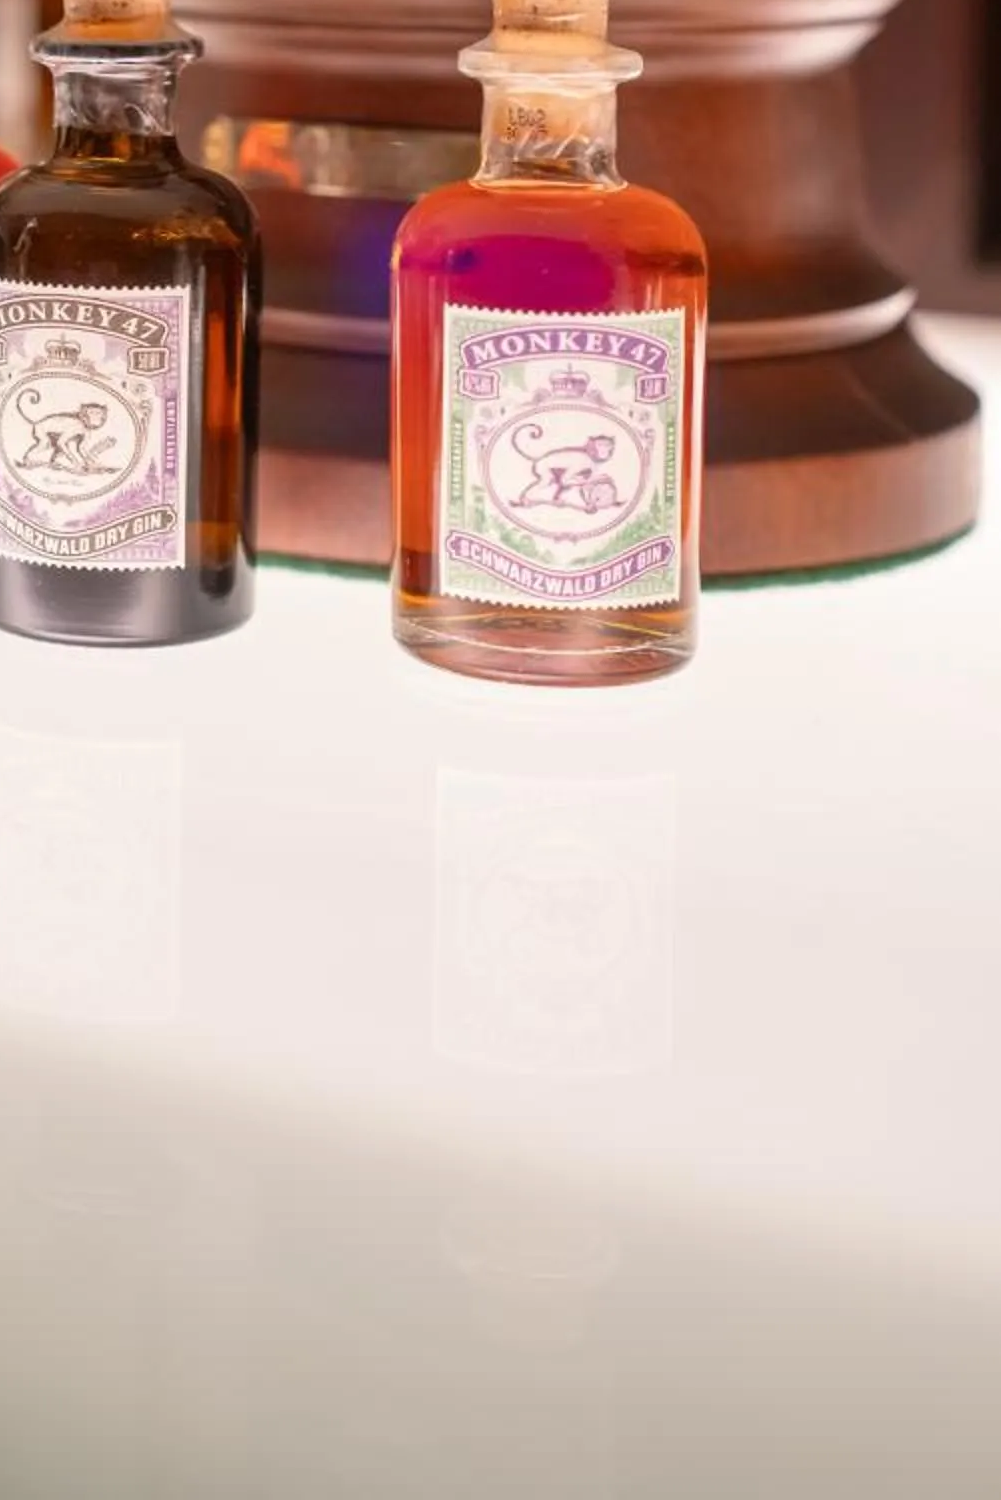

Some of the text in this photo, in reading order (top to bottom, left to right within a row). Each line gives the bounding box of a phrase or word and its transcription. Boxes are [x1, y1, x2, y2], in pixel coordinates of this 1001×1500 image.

[122, 317, 159, 339] 47
[470, 331, 662, 365] MONKEY 47
[94, 523, 130, 548] DRY
[132, 512, 162, 534] GIN
[459, 538, 664, 597] SCHWARZWALD DRY GIN
